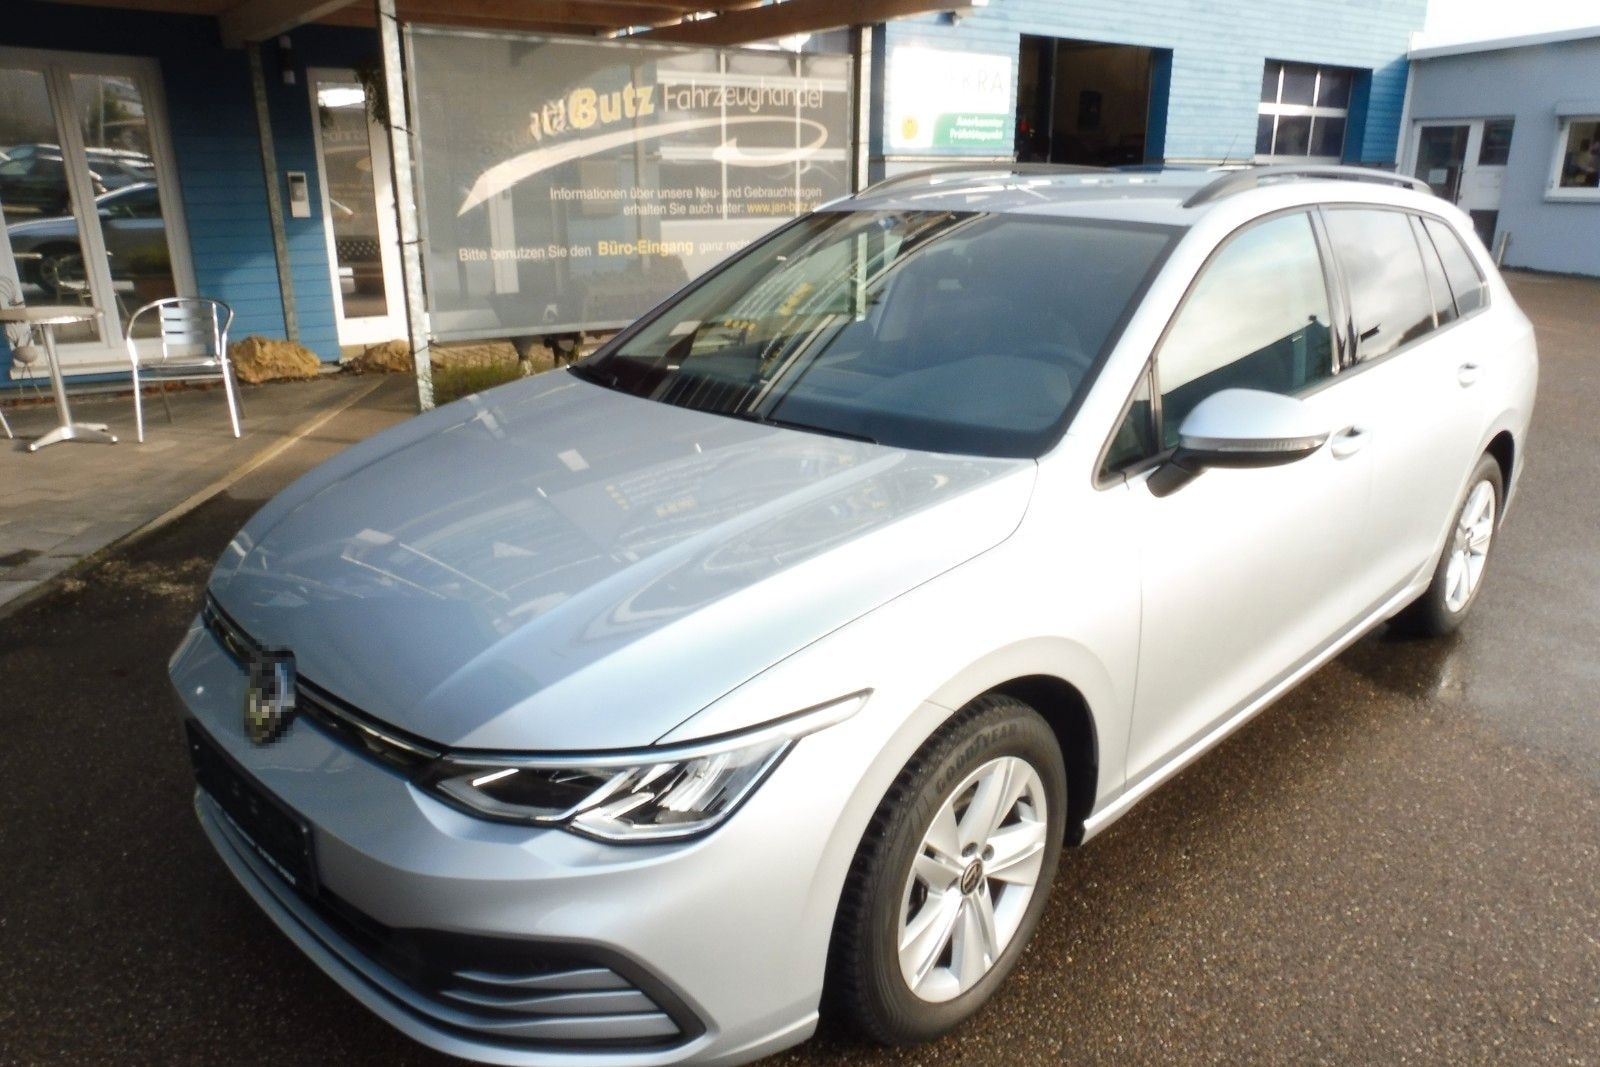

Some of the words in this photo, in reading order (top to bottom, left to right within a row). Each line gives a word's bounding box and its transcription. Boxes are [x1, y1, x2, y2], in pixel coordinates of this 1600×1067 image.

[568, 82, 655, 130] Butz
[663, 77, 824, 113] Fahrzeughandel
[550, 187, 627, 200] Informationen
[630, 186, 655, 199] über
[657, 188, 693, 199] unsere
[623, 203, 667, 216] erhalten
[669, 203, 686, 215] Sie
[689, 202, 714, 214] auch
[459, 247, 488, 261] Bitte
[491, 247, 545, 261] benutzen
[548, 244, 568, 258] Sie
[570, 244, 592, 257] den
[598, 240, 694, 257] Büro-Eingang
